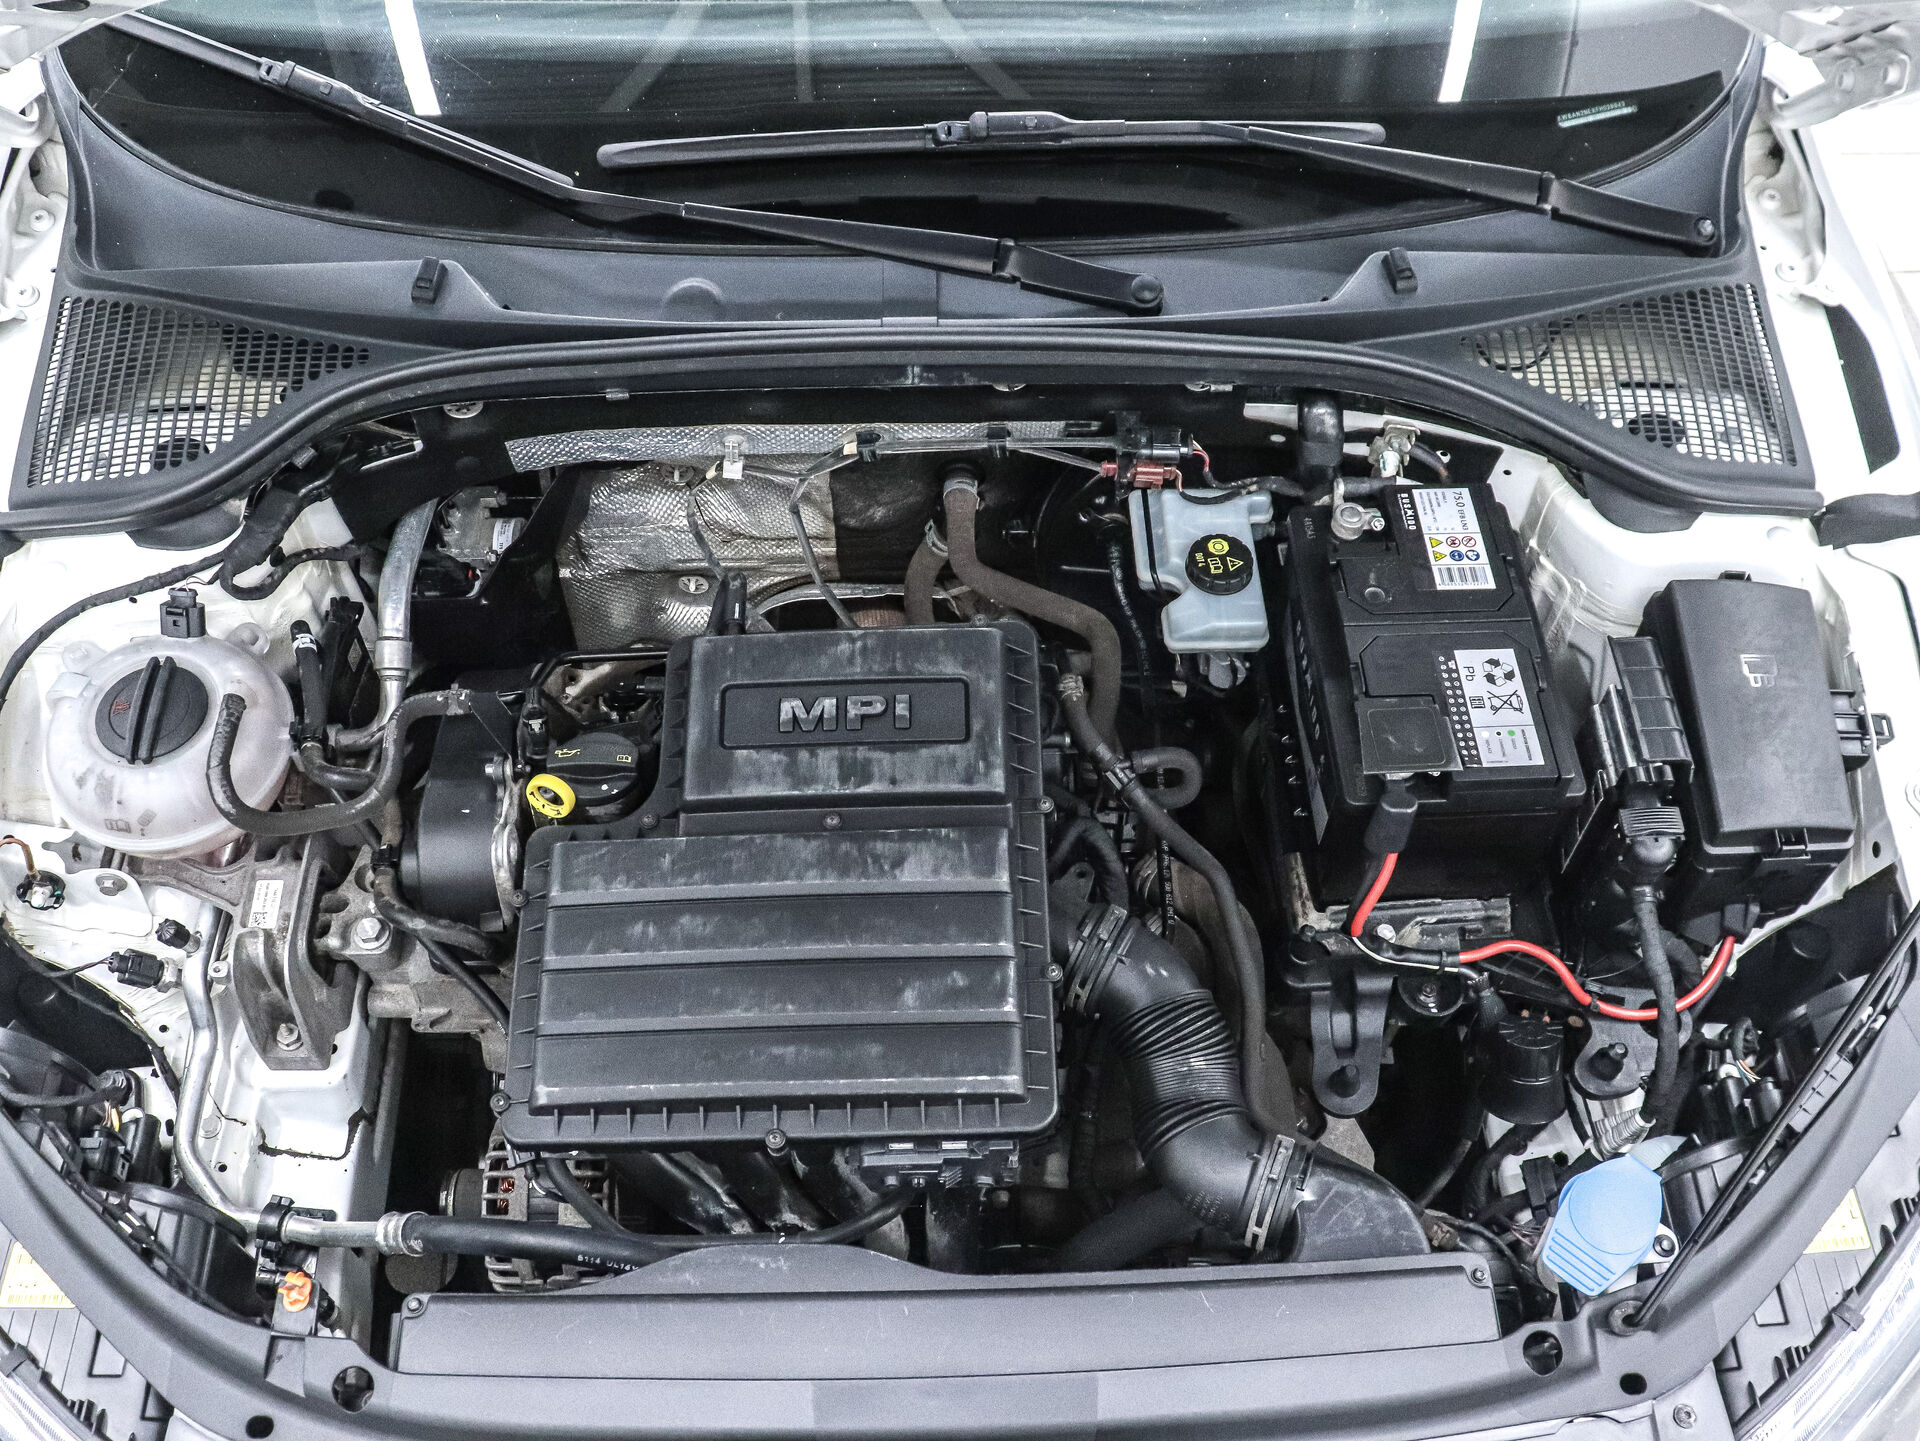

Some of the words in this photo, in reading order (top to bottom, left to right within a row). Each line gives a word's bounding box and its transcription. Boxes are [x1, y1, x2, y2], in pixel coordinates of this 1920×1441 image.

[1452, 491, 1465, 507] 75.0
[1457, 509, 1465, 519] EFB
[1460, 519, 1468, 531] LN3
[1195, 552, 1205, 562] DOT
[1463, 666, 1475, 682] Pb
[778, 693, 912, 732] MPI
